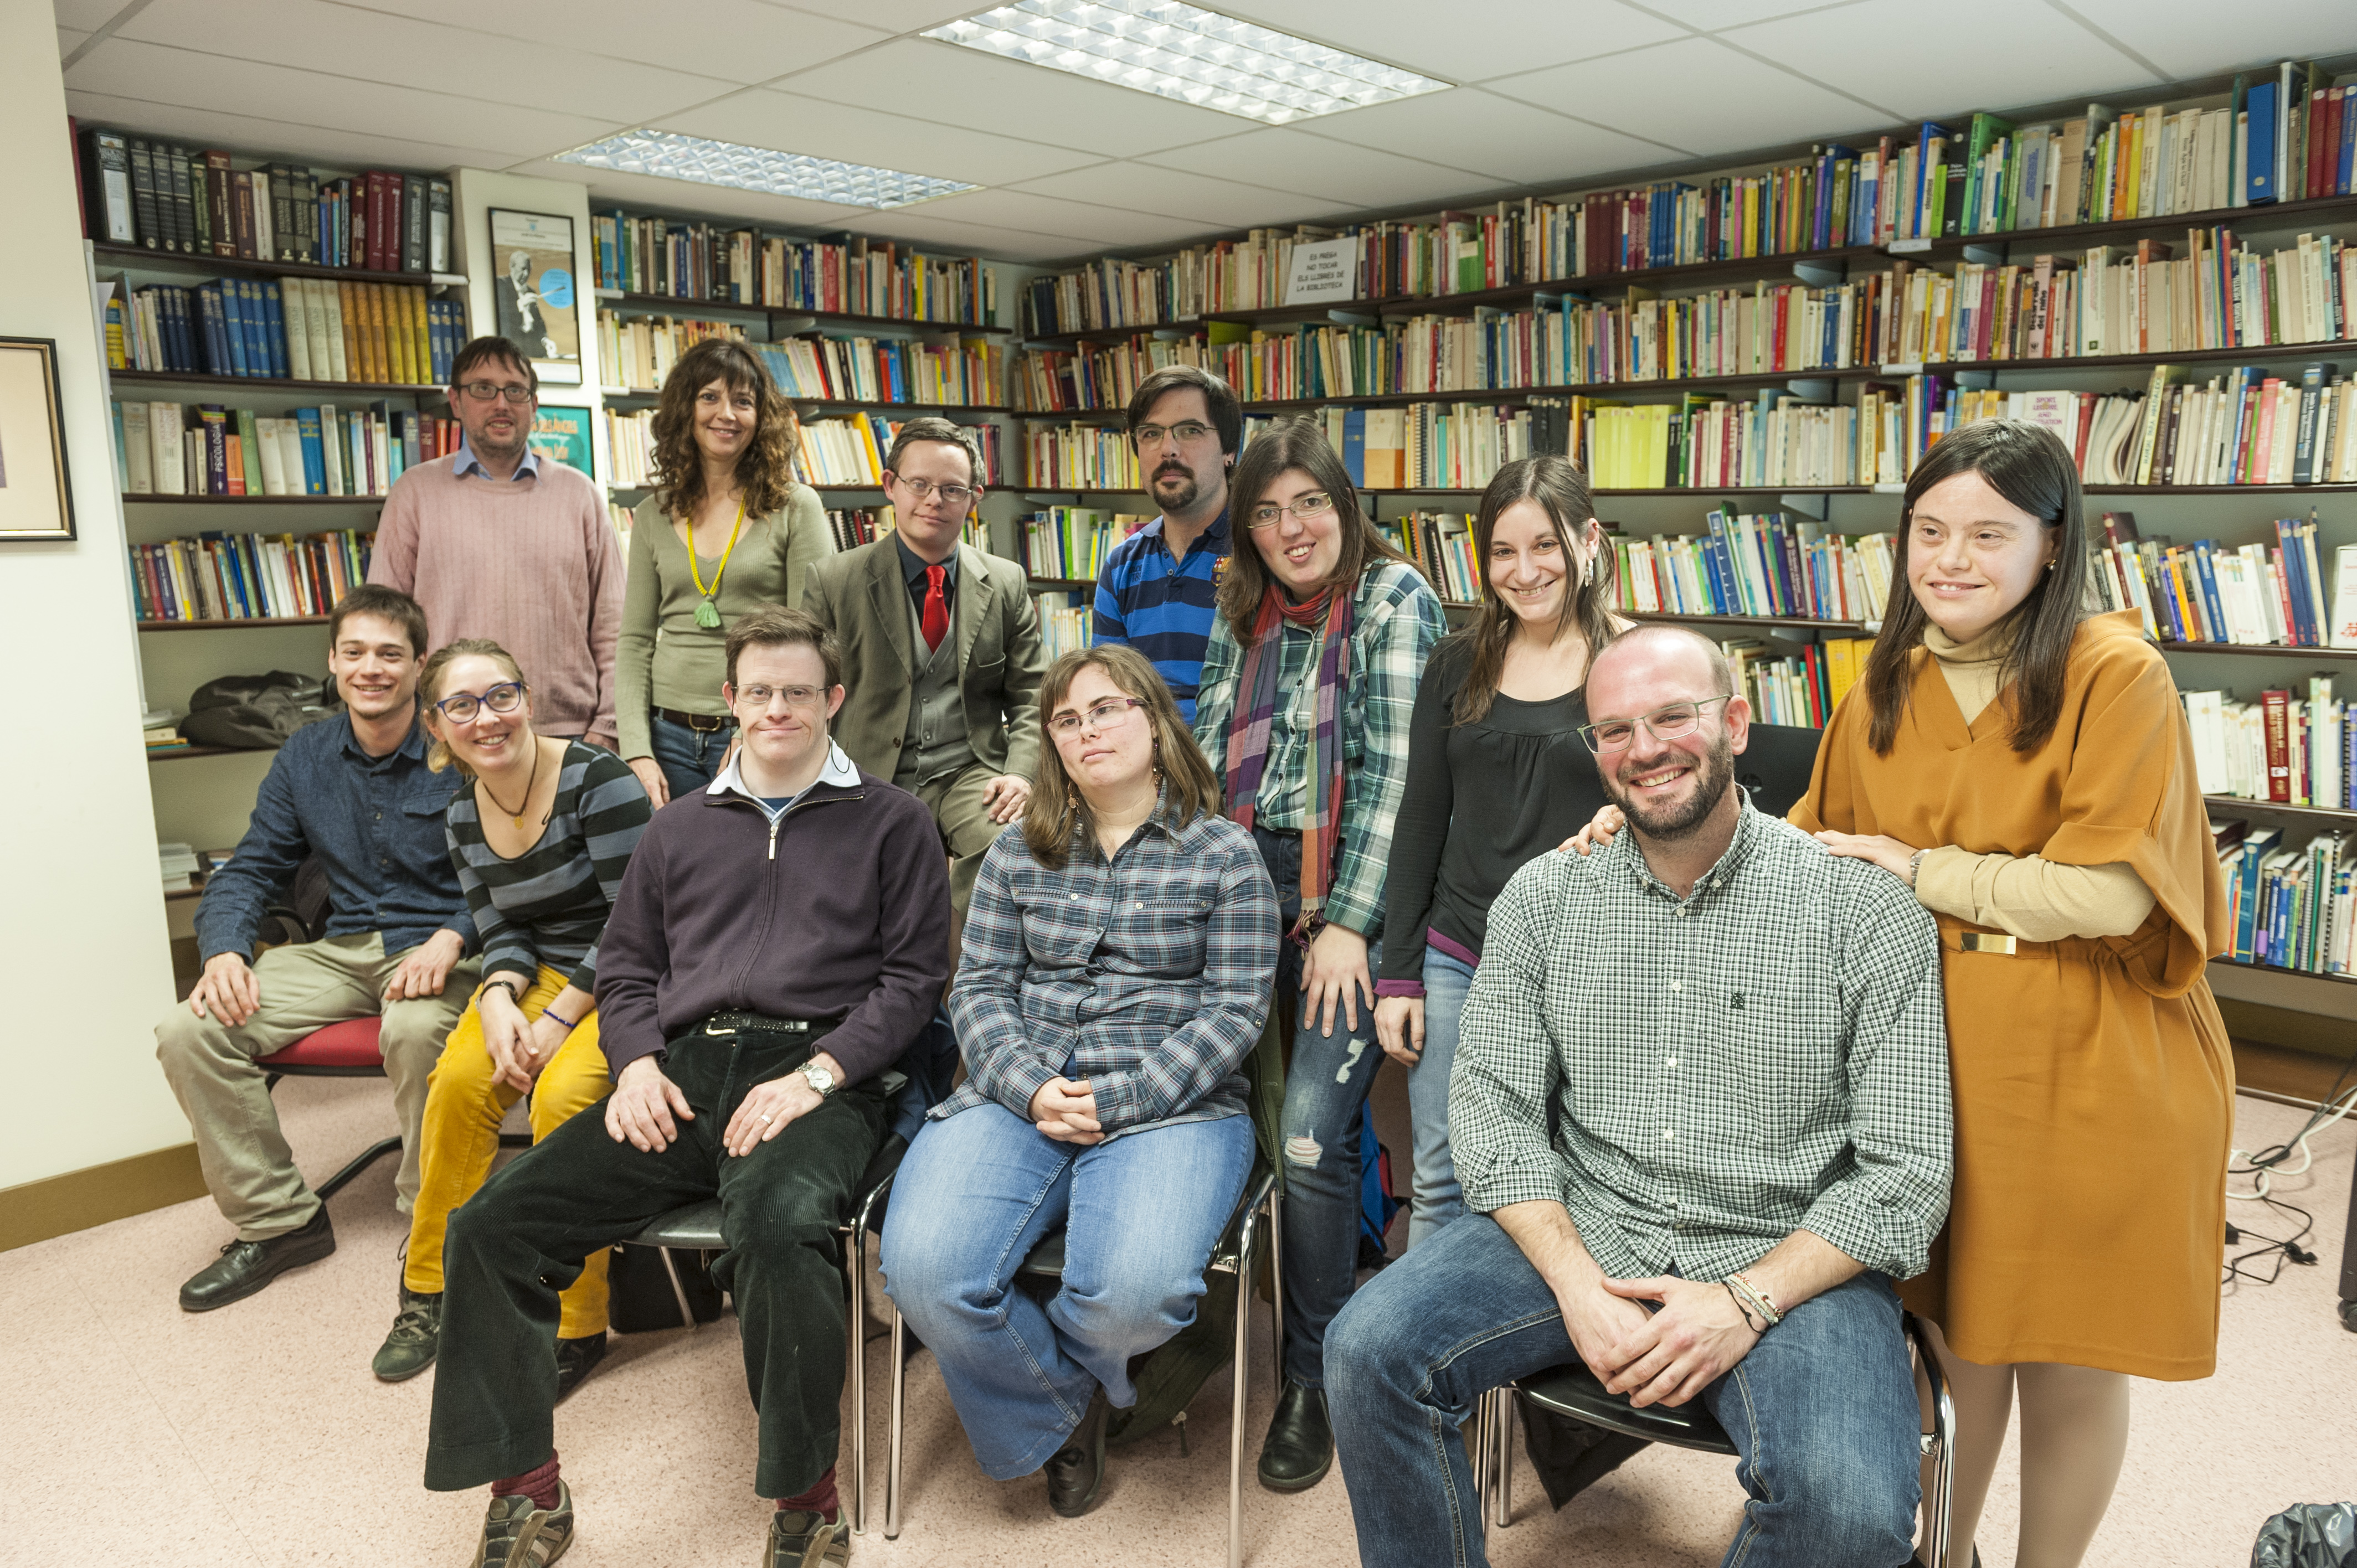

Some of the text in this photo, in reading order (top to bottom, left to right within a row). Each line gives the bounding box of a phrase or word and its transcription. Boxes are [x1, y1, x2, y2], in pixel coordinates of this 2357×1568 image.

[1319, 251, 1337, 259] PREGA
[1306, 261, 1338, 271] NO TOCAR
[1298, 273, 1309, 282] ELS
[1310, 271, 1335, 281] LLIBRES
[1296, 282, 1342, 292] LA BIBLIOTECA
[2232, 275, 2241, 301] MENTAL
[431, 304, 436, 312] 1
[443, 305, 449, 313] 2
[2030, 281, 2039, 331] Desarrollo
[2036, 290, 2047, 329] del niño
[110, 357, 118, 367] L
